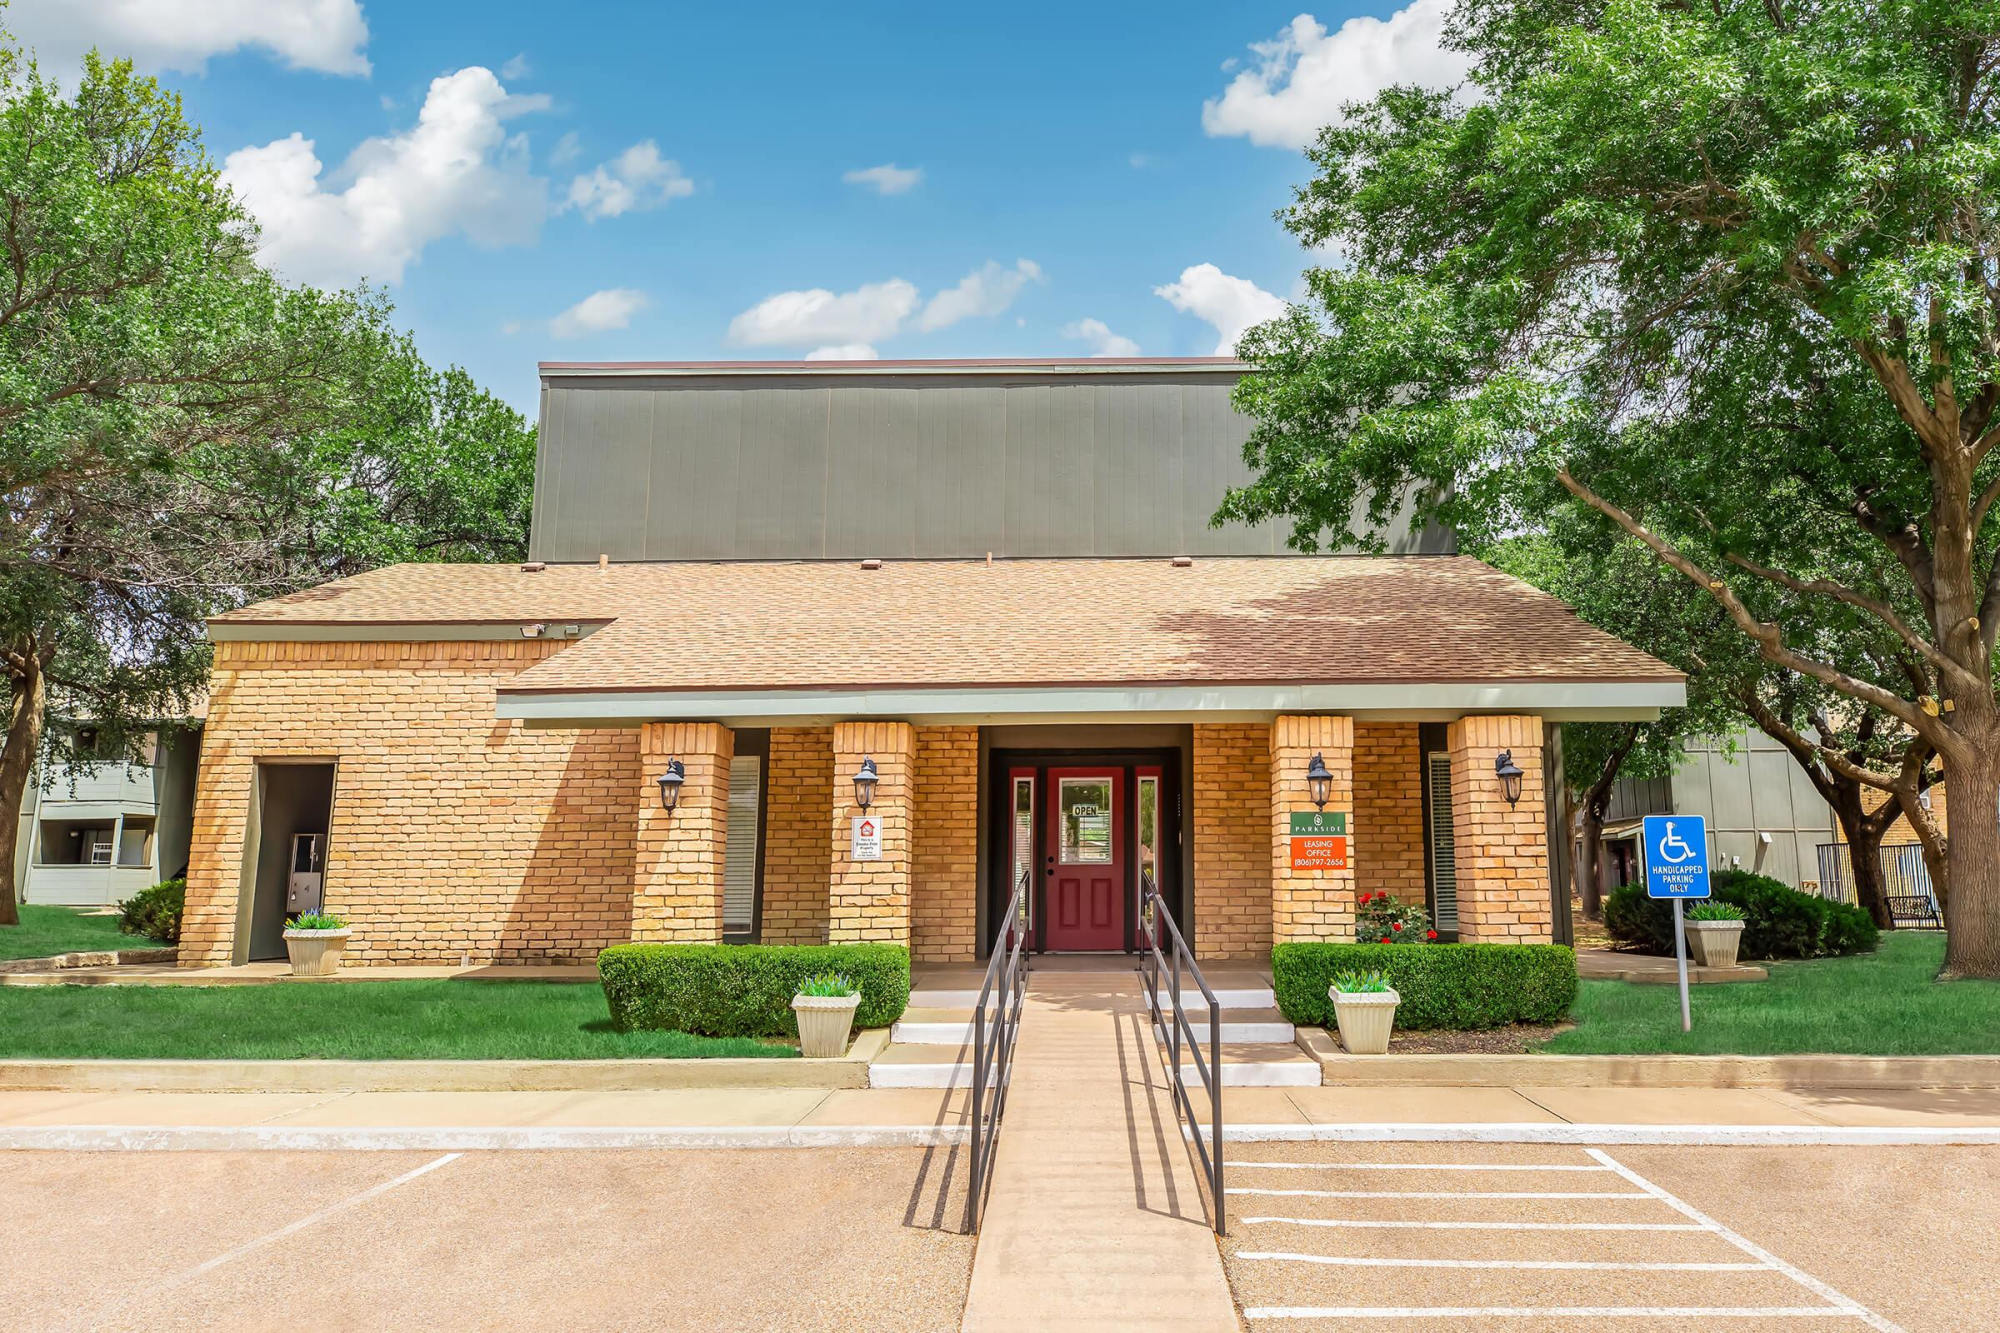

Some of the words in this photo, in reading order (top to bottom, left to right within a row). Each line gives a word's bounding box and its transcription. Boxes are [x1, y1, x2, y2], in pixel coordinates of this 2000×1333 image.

[1074, 806, 1097, 816] OPEN
[1304, 840, 1333, 848] LEASING
[1306, 849, 1332, 857] OFFICE
[1652, 865, 1703, 874] HANDICAPPED
[1662, 874, 1694, 883] PARKING
[1669, 884, 1688, 893] ONLY
